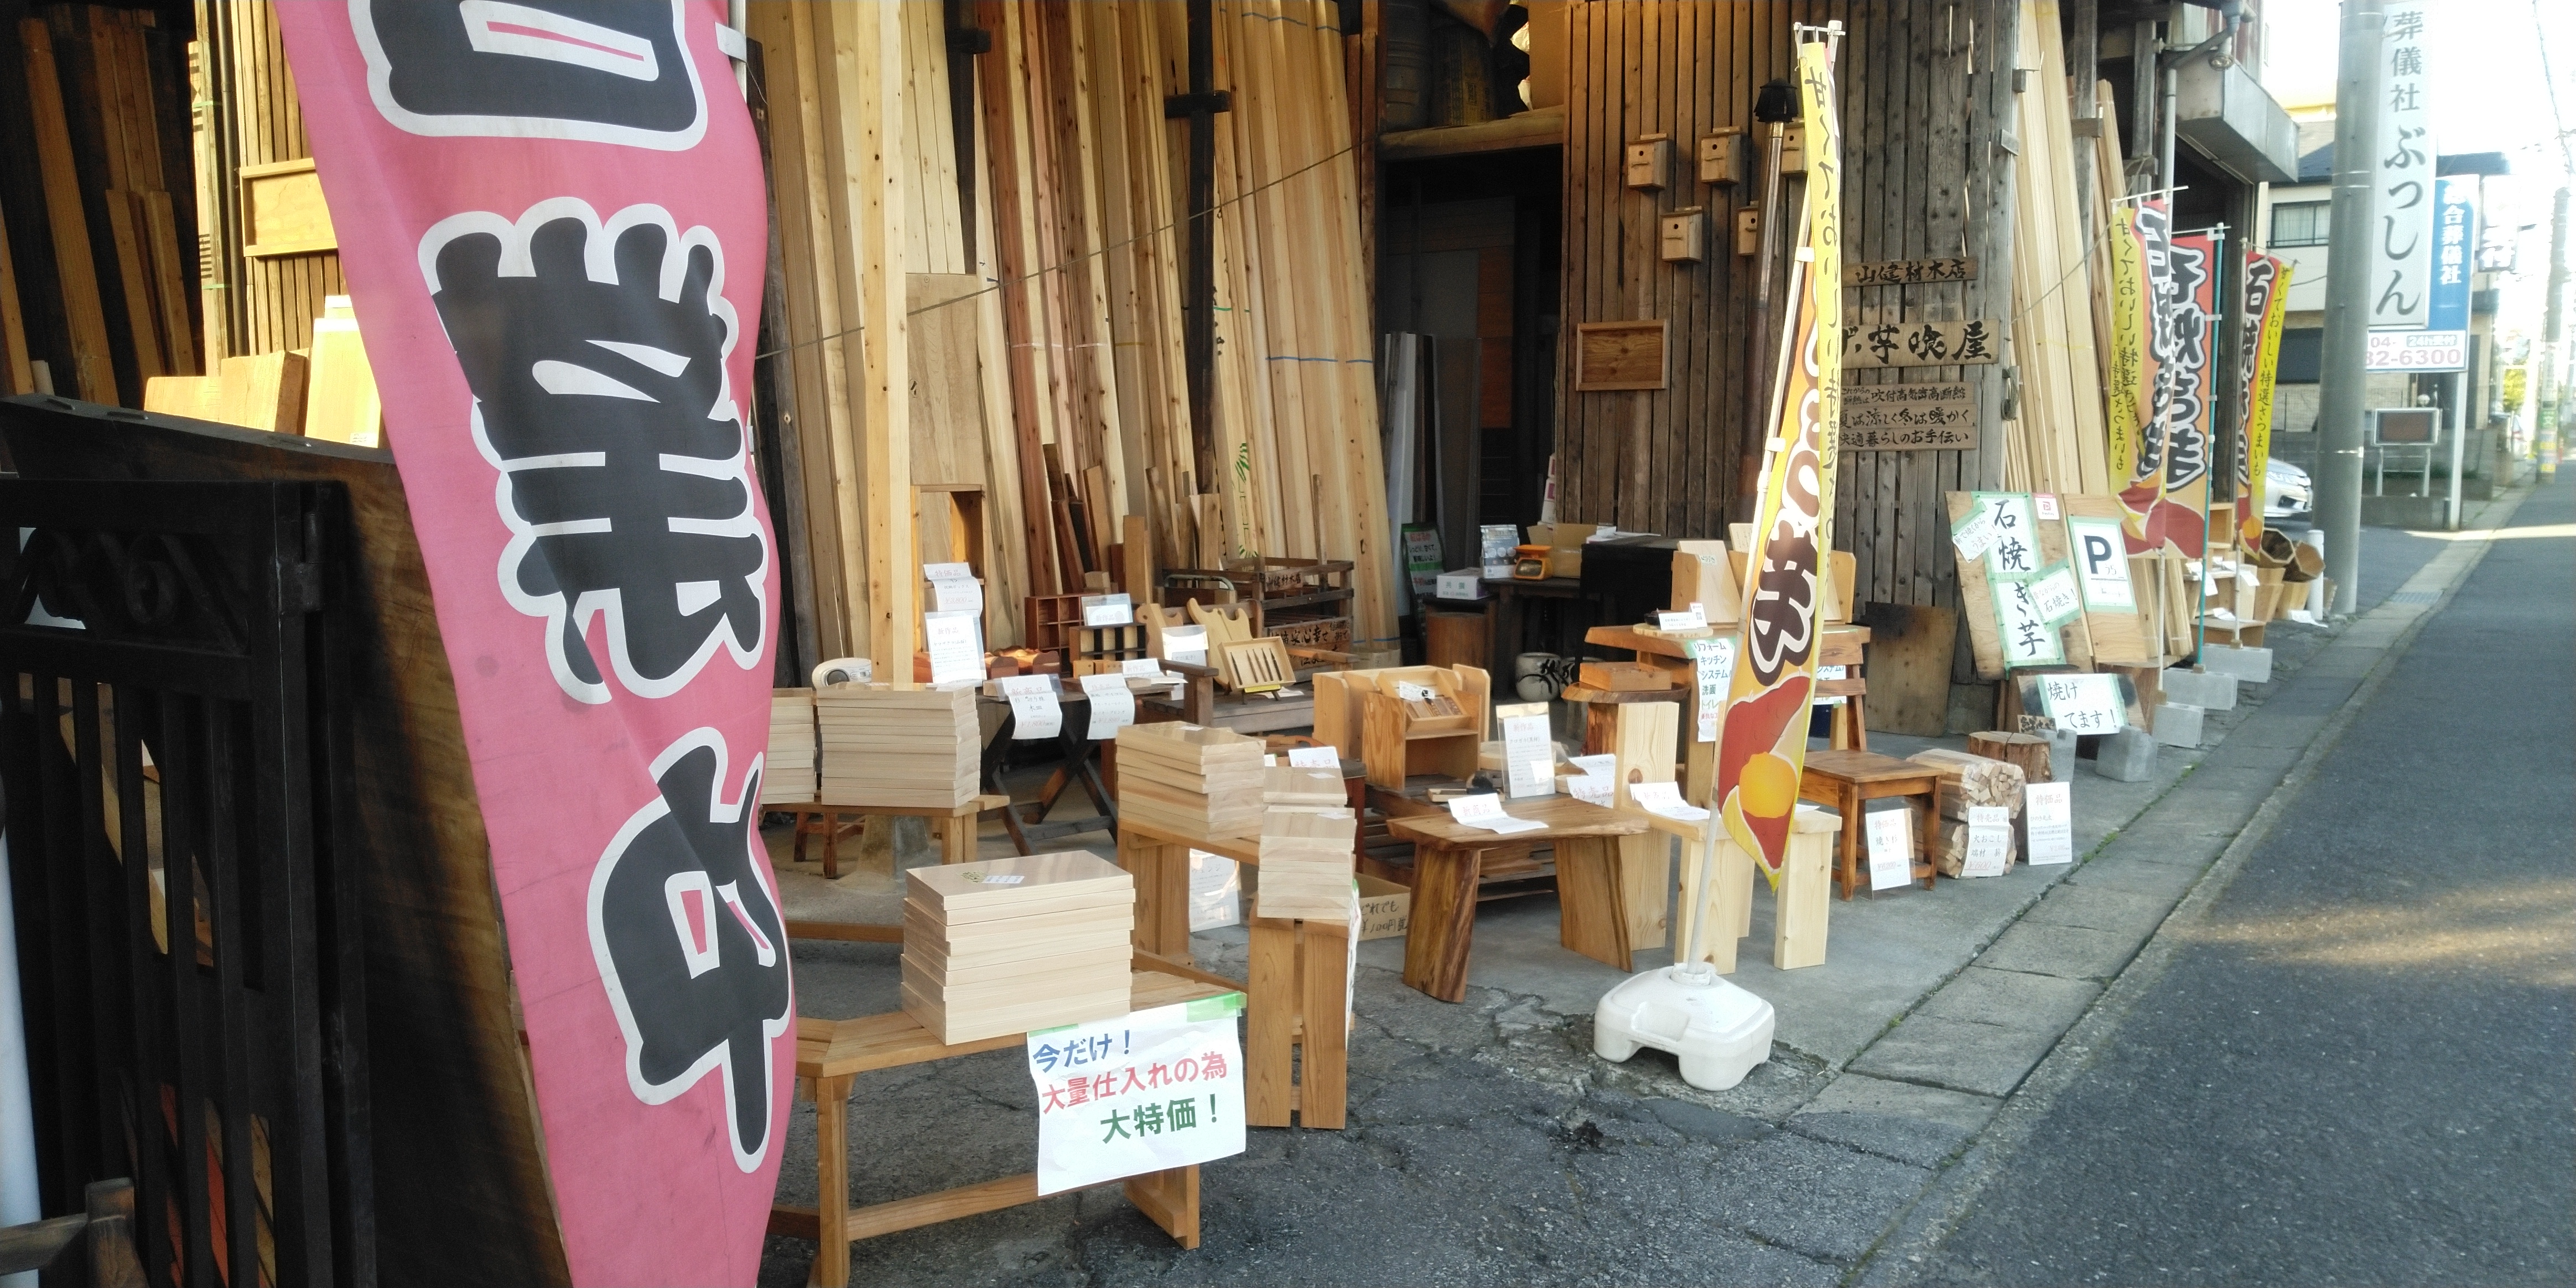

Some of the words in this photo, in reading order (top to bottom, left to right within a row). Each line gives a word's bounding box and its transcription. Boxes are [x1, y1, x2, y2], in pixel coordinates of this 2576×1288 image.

[2440, 185, 2465, 285] 合葬儀社
[934, 569, 961, 577] 特価品
[2083, 535, 2112, 574] P
[1701, 685, 1716, 695] 洗面
[1973, 834, 2002, 843] 火おこし
[1032, 1029, 1130, 1072] 今だけ！
[1042, 1051, 1228, 1114] 大量仕入れの為
[1100, 1093, 1218, 1144] 大特価！
